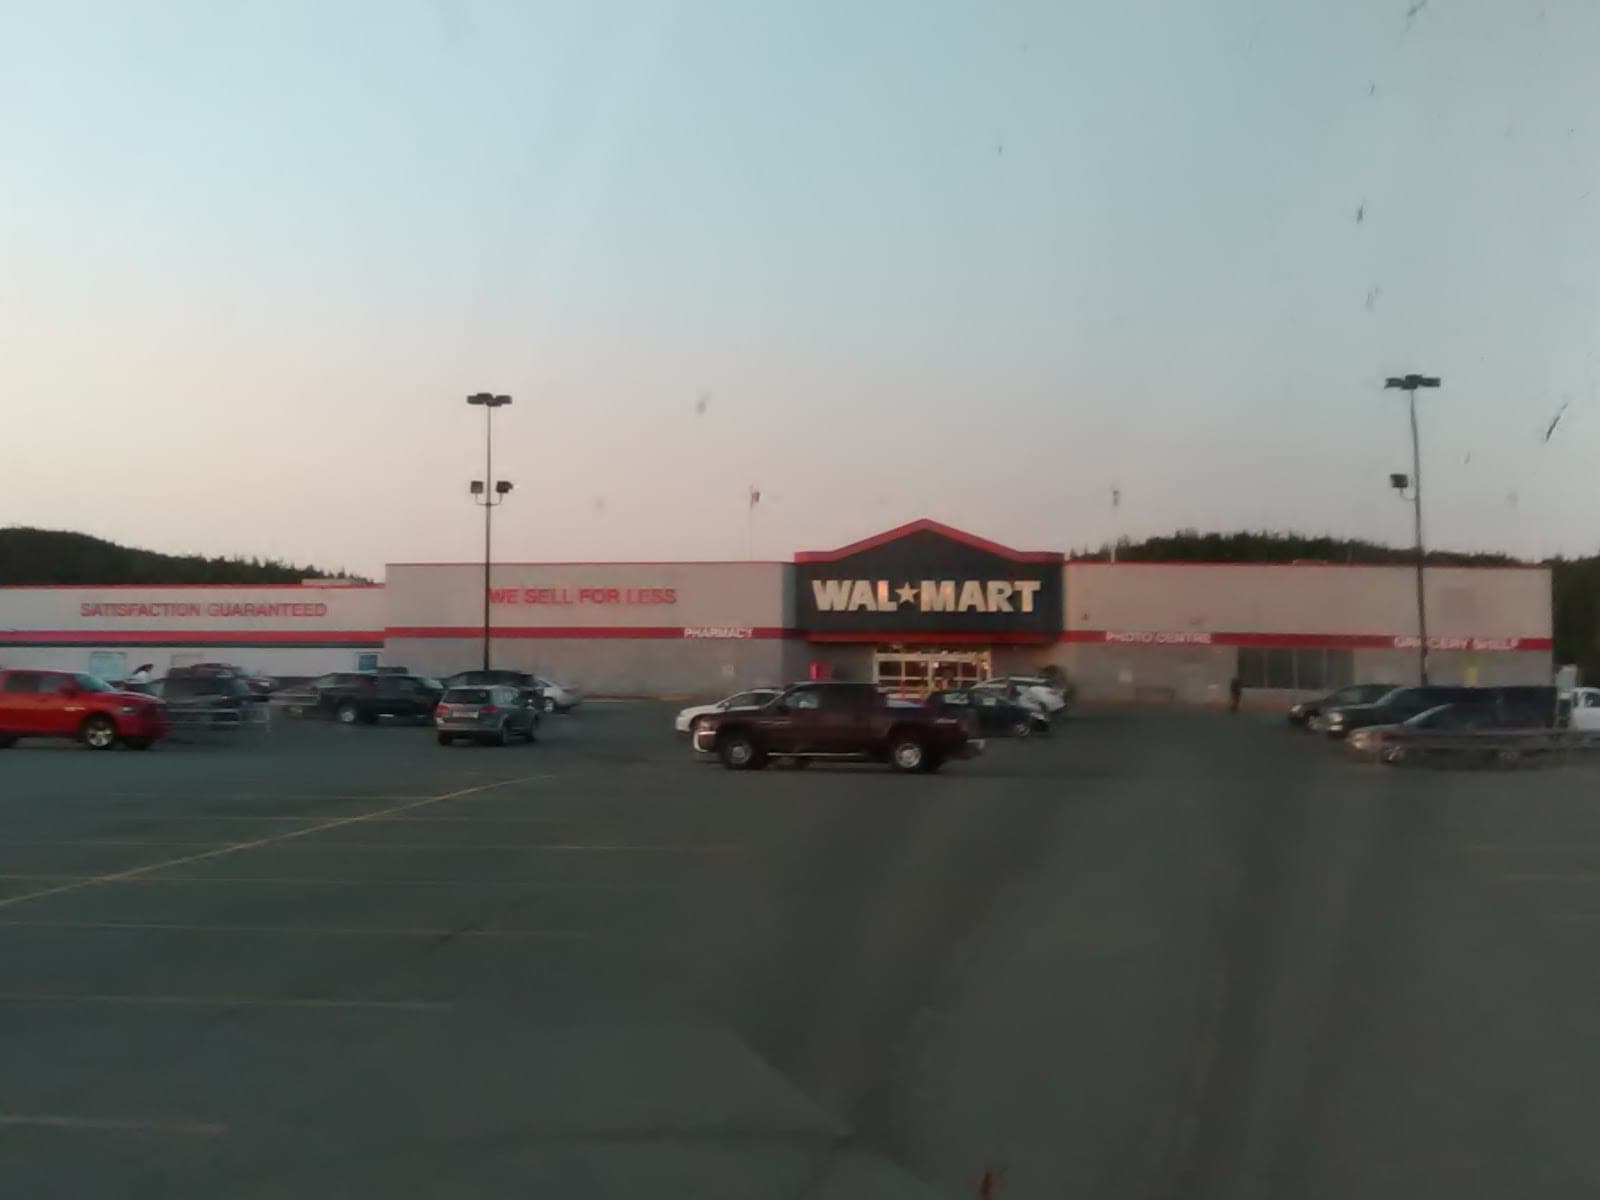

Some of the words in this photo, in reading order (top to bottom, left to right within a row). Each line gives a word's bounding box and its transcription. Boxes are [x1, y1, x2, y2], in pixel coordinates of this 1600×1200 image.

[488, 588, 518, 604] WE
[524, 588, 573, 604] SELL
[579, 588, 620, 604] FOR
[626, 588, 677, 604] LESS
[812, 579, 898, 612] WAL
[920, 580, 1041, 613] MART
[80, 602, 200, 617] SATISFACTION
[207, 602, 327, 617] GUARANTEED
[683, 627, 753, 640] PHARMACY
[1105, 631, 1153, 643] PHOTO
